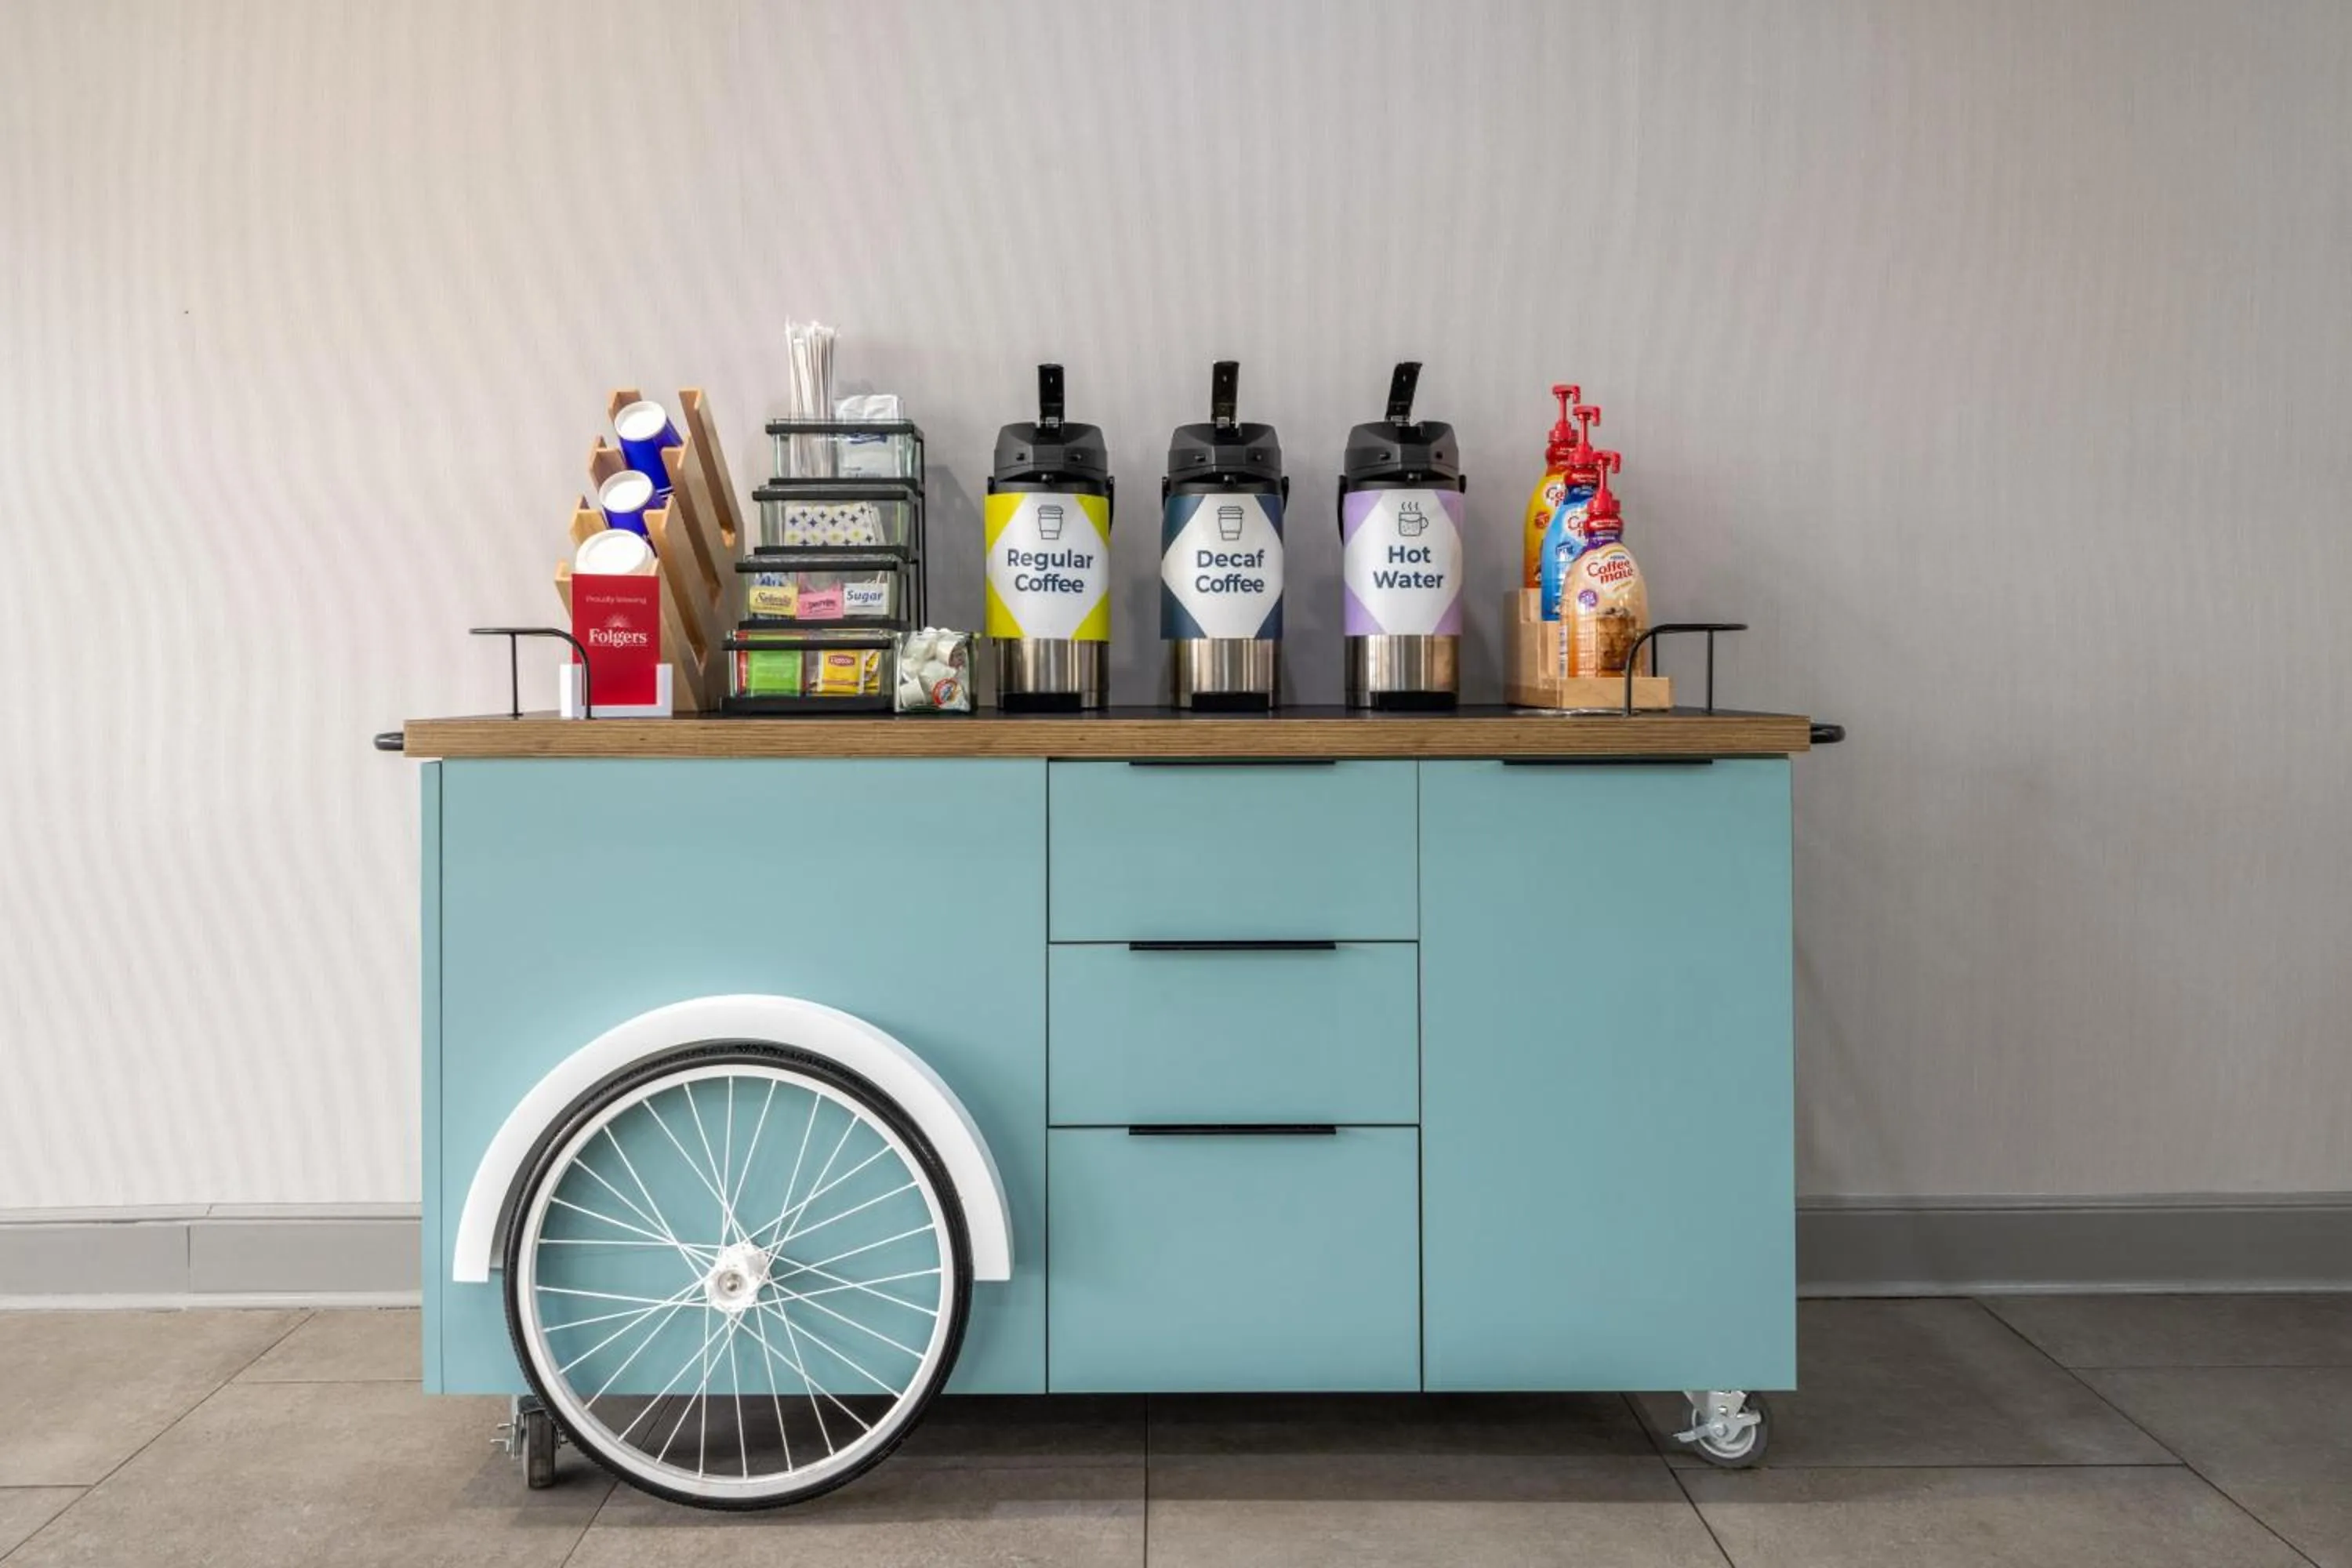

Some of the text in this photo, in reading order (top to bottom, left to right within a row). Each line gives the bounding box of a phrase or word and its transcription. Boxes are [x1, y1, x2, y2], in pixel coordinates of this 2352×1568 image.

[1007, 548, 1094, 572] Regular
[1196, 549, 1265, 568] Decaf
[1388, 545, 1431, 564] Hot
[1587, 560, 1631, 577] Coffee
[1014, 573, 1084, 593] Coffee
[1195, 574, 1265, 593] Coffee
[1373, 570, 1444, 589] Water
[846, 589, 884, 603] Sugar
[589, 628, 648, 648] Folgers
